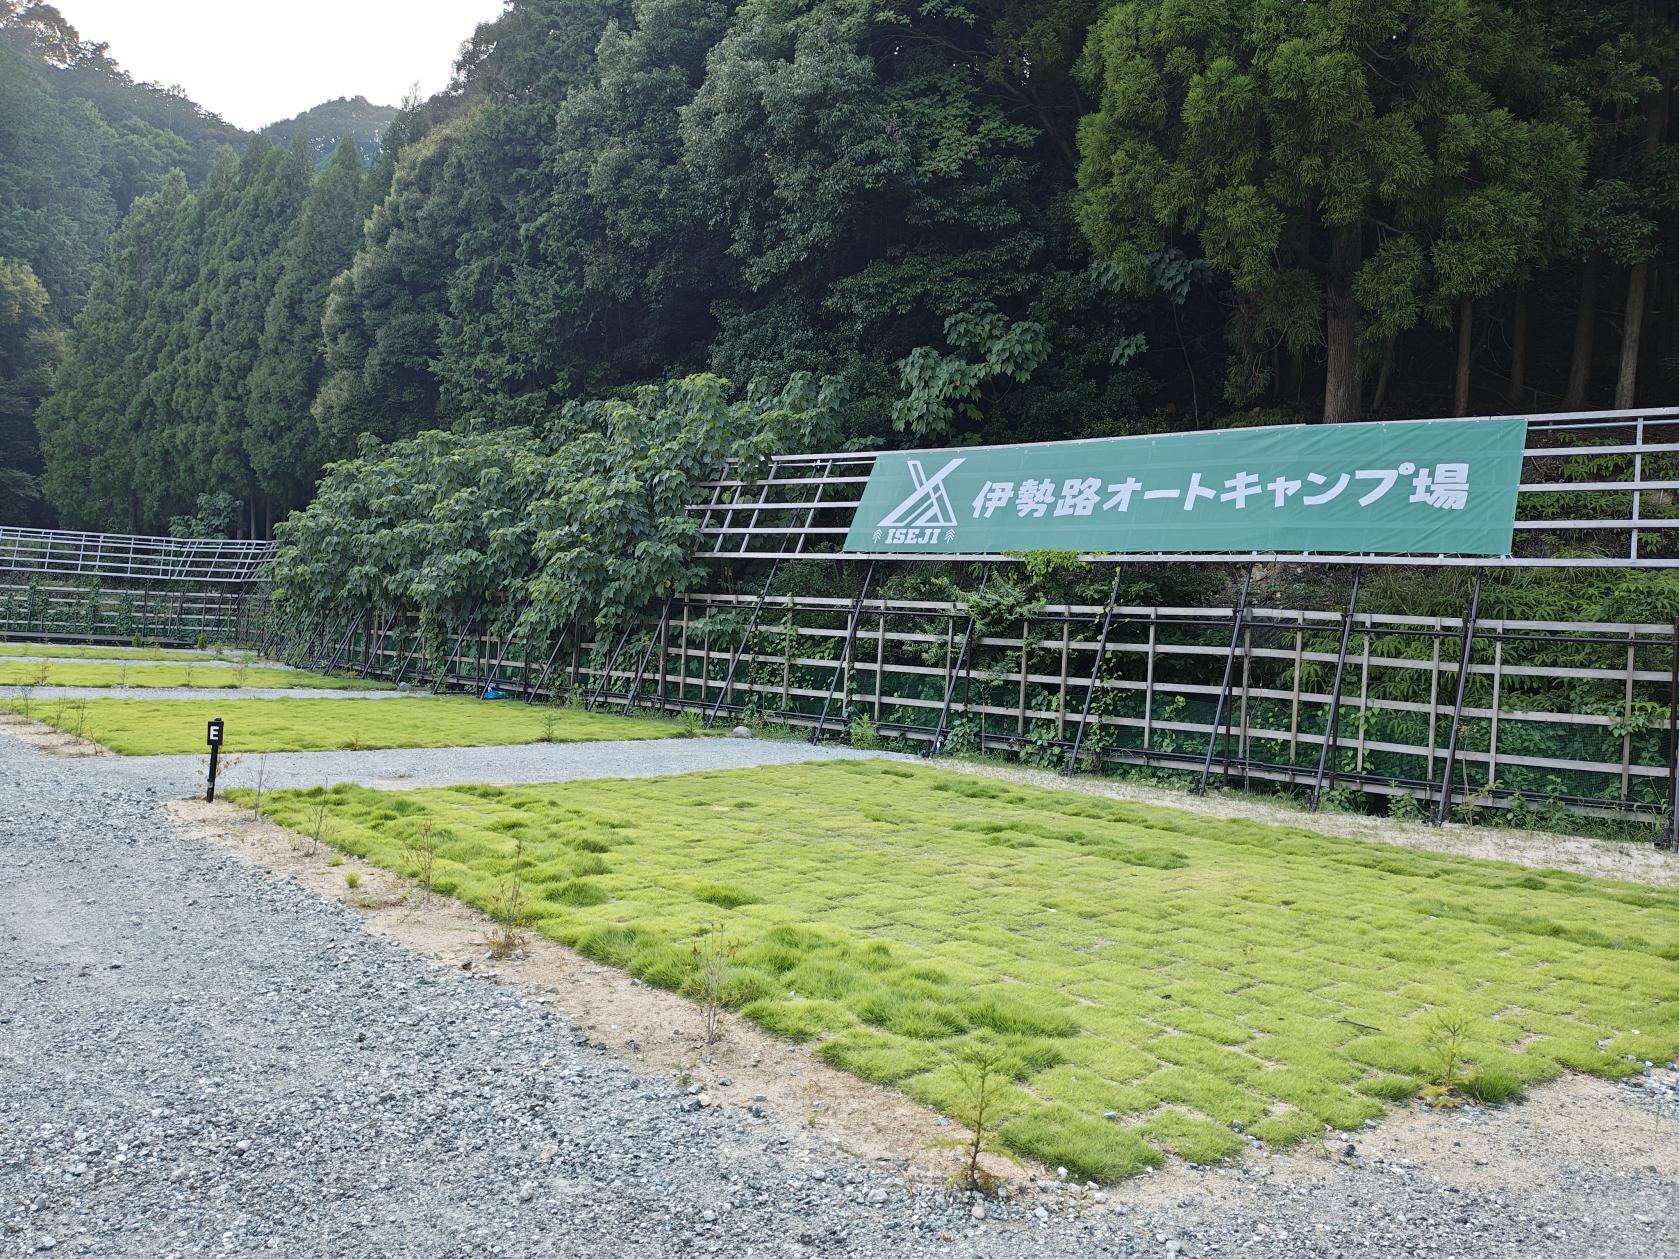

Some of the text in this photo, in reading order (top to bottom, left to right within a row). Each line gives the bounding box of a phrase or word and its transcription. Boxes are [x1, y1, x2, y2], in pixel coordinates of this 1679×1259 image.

[971, 462, 1470, 519] 伊勢路オートキャンプ場
[884, 528, 942, 545] ISEJI
[209, 725, 220, 741] E
